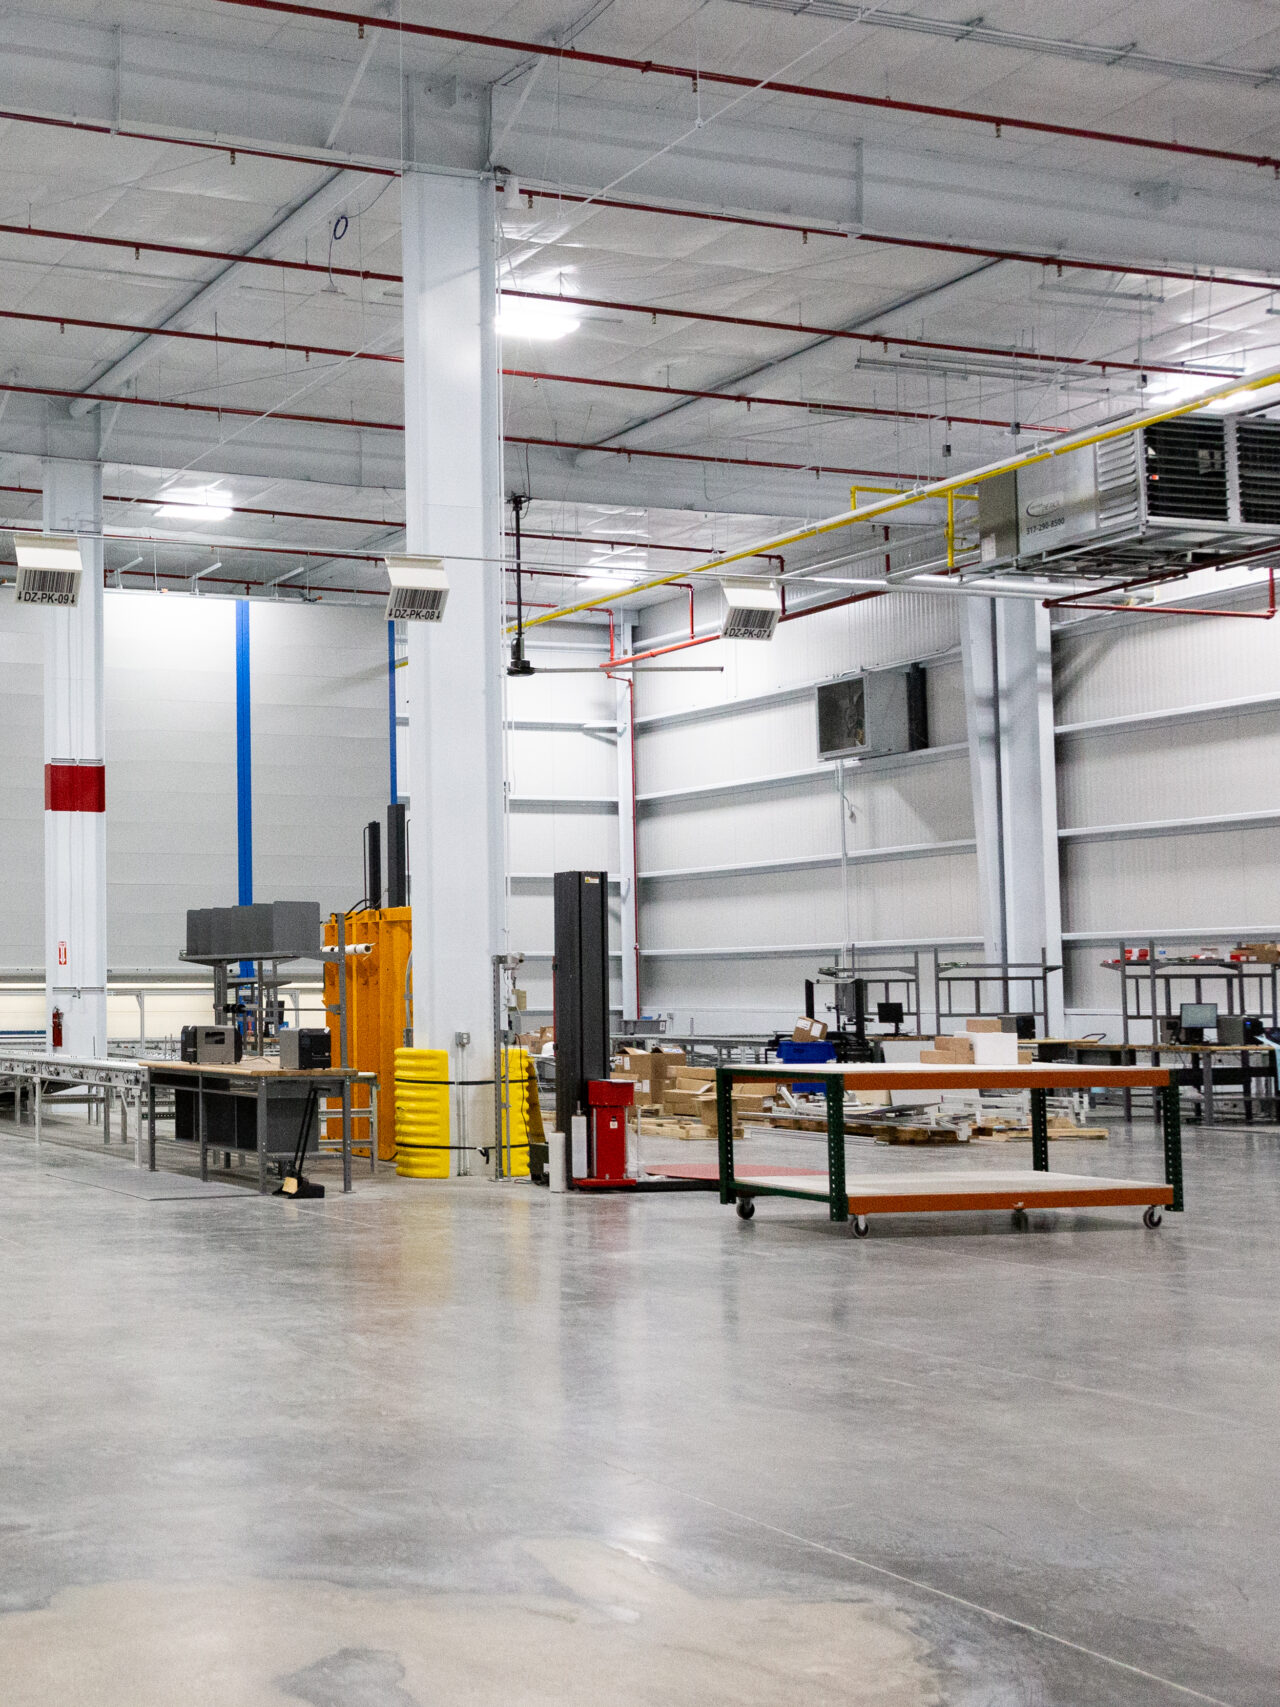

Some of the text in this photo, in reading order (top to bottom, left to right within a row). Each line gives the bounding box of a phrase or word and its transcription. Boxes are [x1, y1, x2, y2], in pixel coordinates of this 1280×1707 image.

[23, 591, 70, 605] DZ-PK-09
[394, 608, 436, 620] DZ-PK-08
[728, 628, 767, 639] DZ-PK-07
